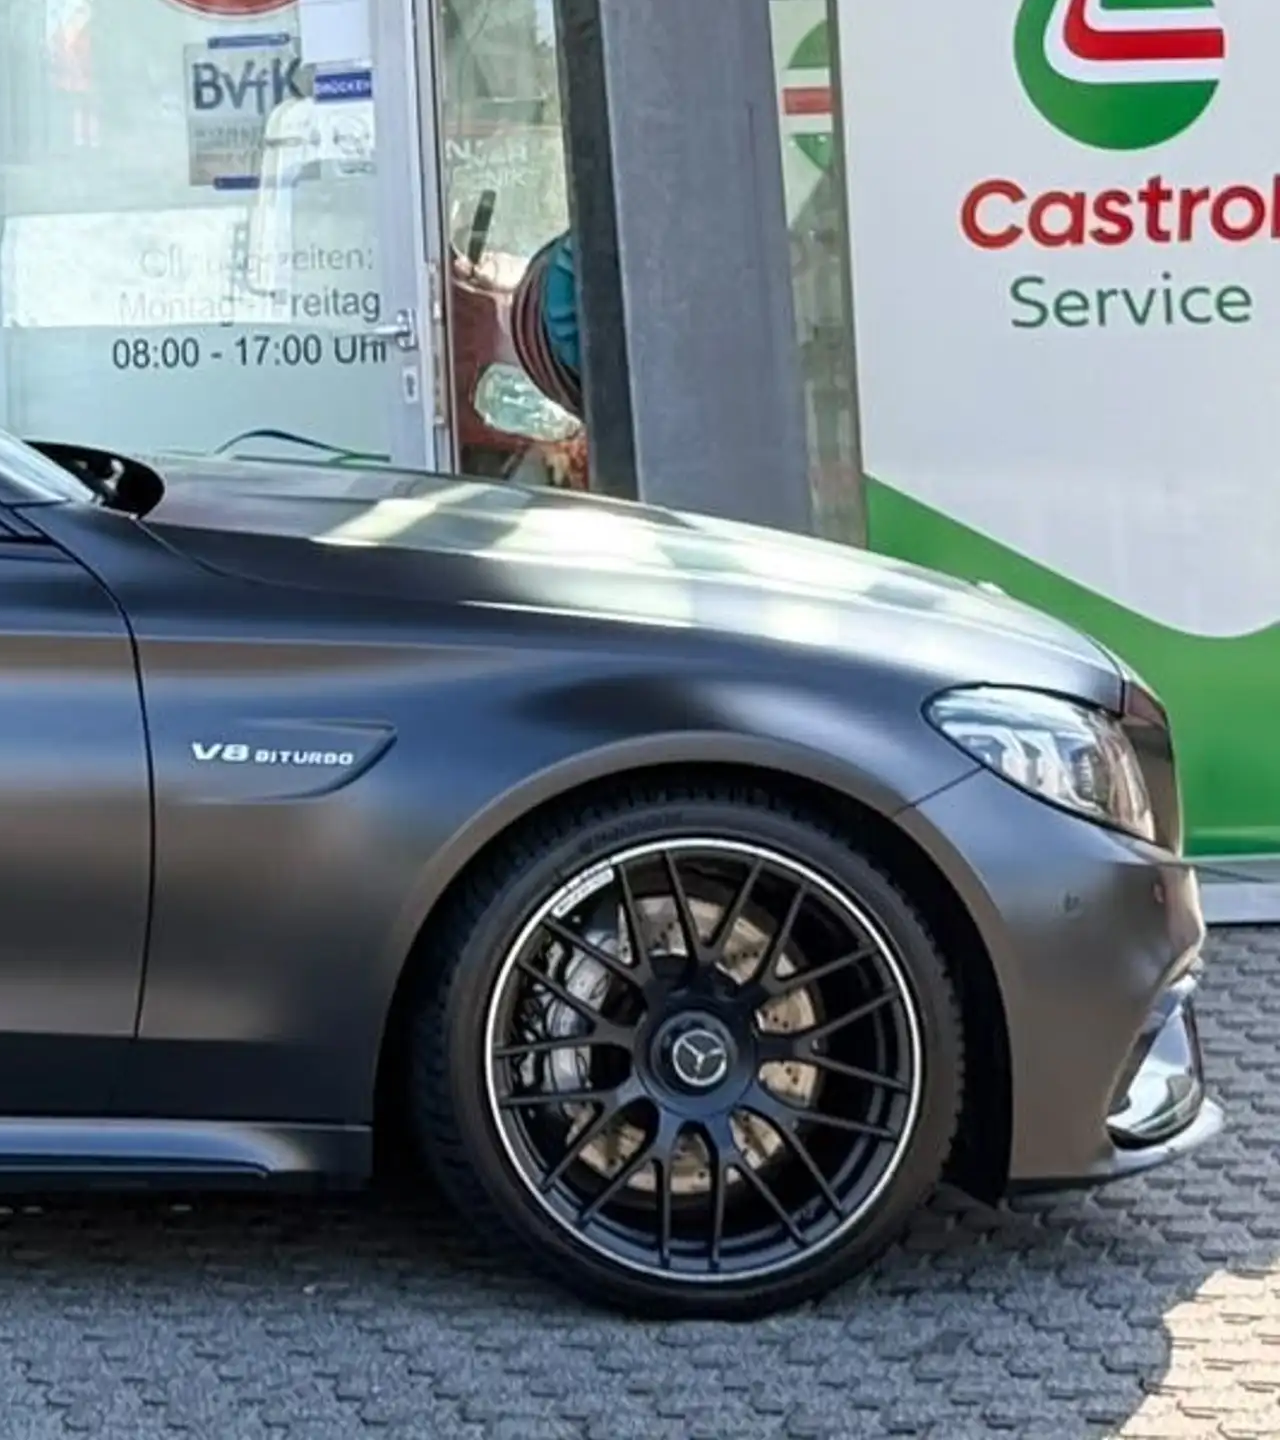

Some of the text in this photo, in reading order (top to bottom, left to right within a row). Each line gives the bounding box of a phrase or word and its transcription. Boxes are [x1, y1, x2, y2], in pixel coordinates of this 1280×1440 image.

[960, 173, 1280, 249] Castrol
[1009, 271, 1253, 329] Service
[112, 336, 200, 370] 08:00
[234, 333, 322, 367] 17:00
[334, 334, 388, 365] Uhr
[191, 741, 354, 766] V8 BITURBO
